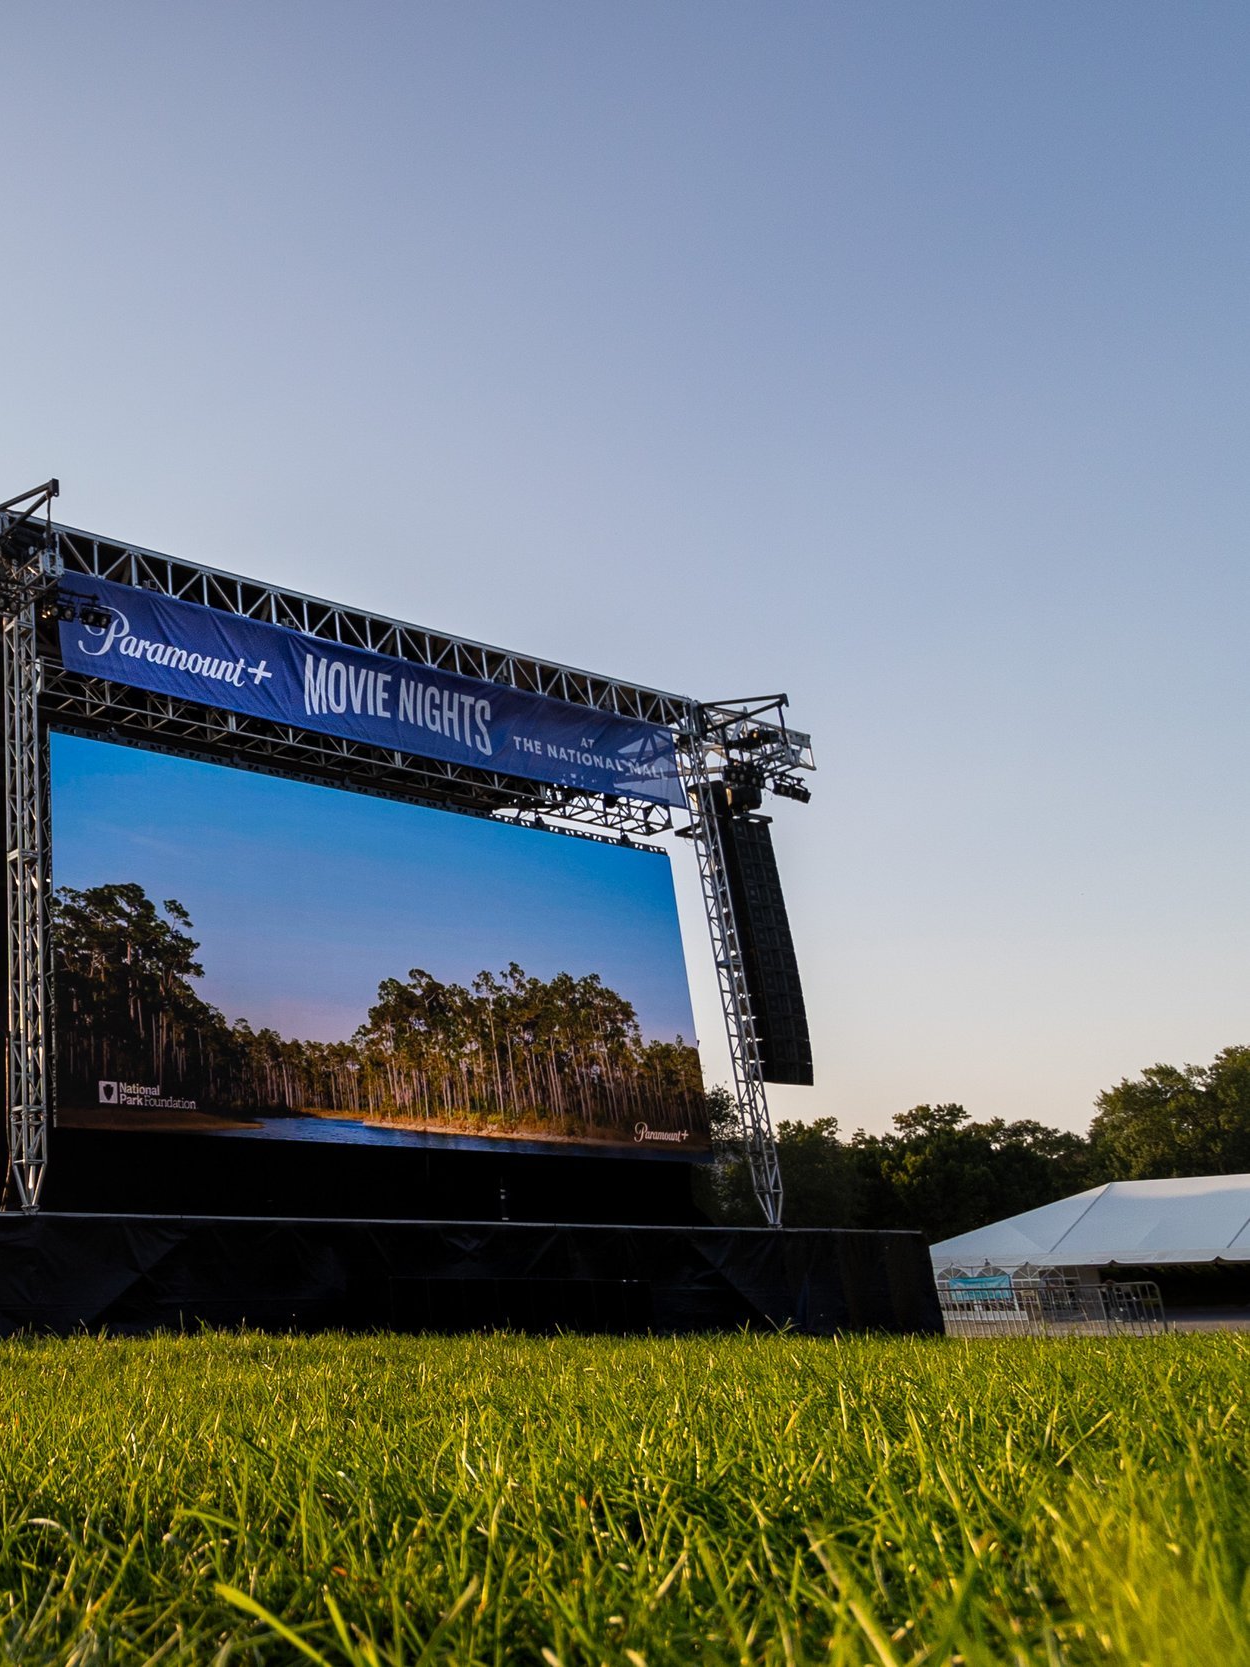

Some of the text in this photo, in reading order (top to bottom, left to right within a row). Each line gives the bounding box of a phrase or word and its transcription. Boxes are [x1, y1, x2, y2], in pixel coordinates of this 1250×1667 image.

[78, 605, 272, 687] Paramount+
[304, 653, 493, 757] MOVIE NIGHTS
[580, 737, 595, 750] AT
[513, 735, 668, 781] THE NATIONAL MALL
[119, 1082, 160, 1096] National
[119, 1094, 196, 1110] Park Foundation
[634, 1121, 689, 1143] Paramount+
